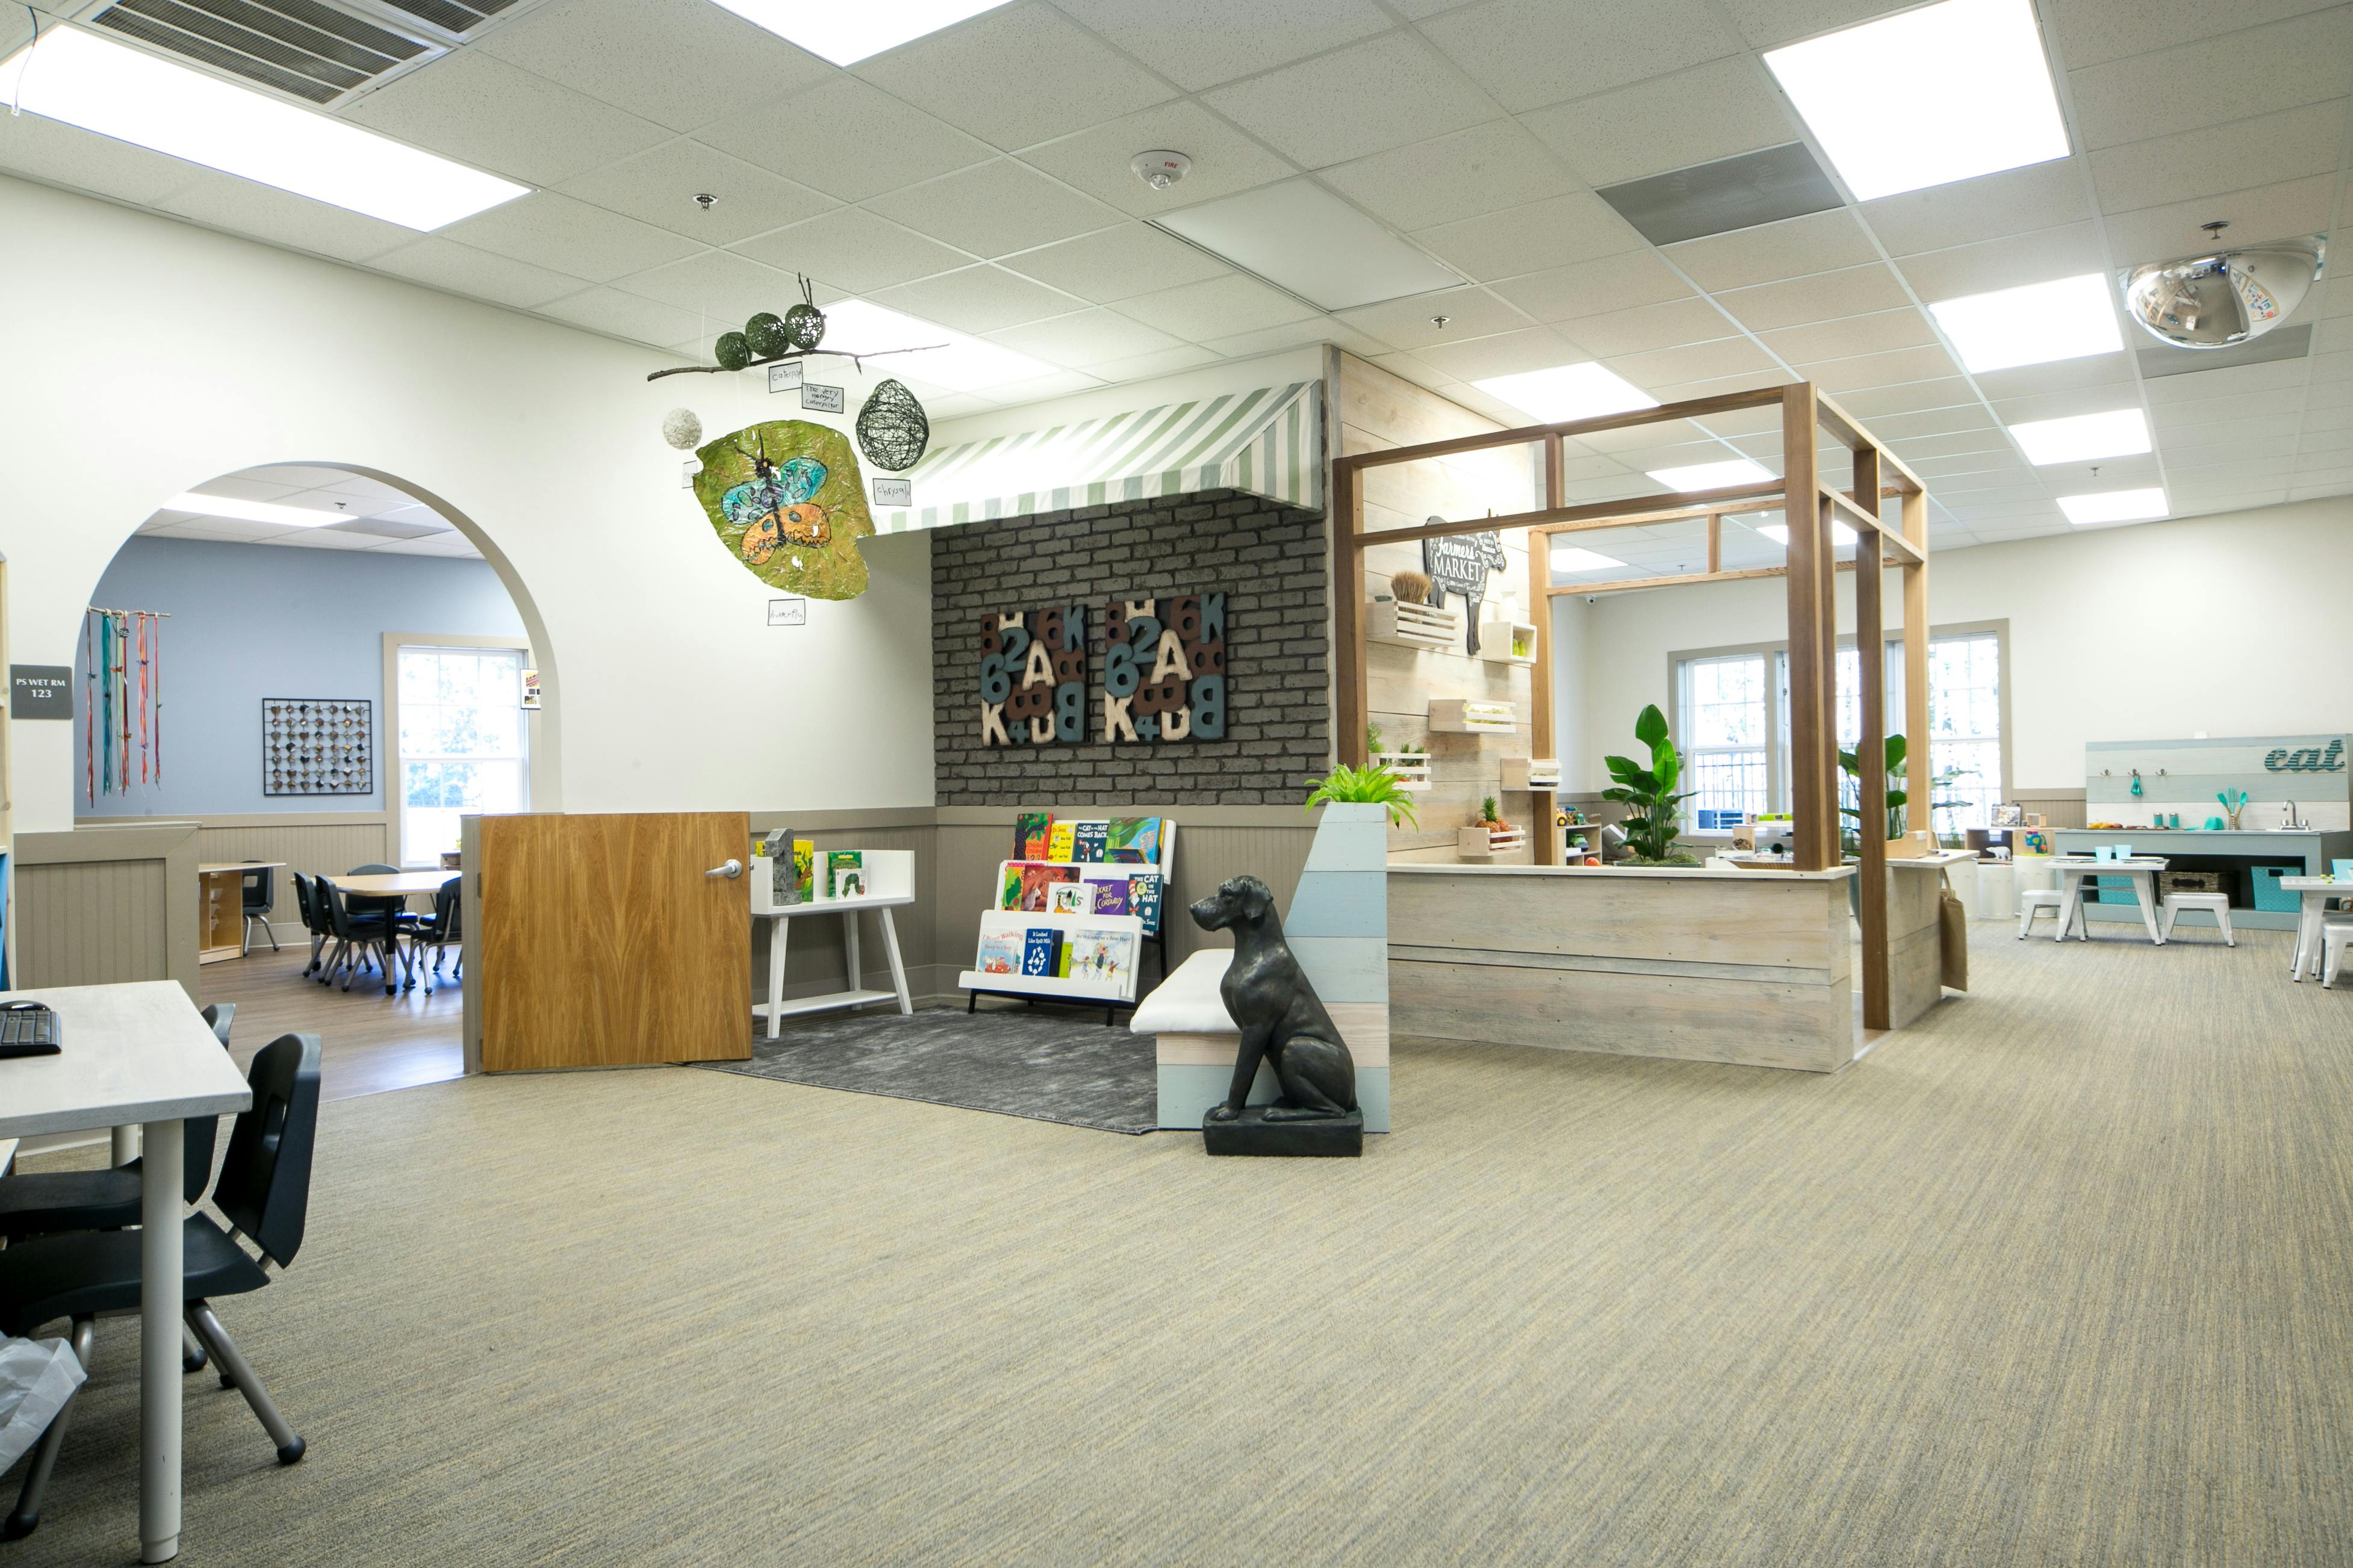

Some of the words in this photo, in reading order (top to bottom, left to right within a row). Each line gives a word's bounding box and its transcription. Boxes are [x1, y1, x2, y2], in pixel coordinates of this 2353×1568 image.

[1433, 554, 1481, 582] MARKET
[31, 689, 52, 698] 123
[2264, 739, 2346, 772] eat
[1097, 884, 1113, 894] OCKET
[1142, 894, 1158, 903] HAT
[1001, 931, 1024, 941] Walking
